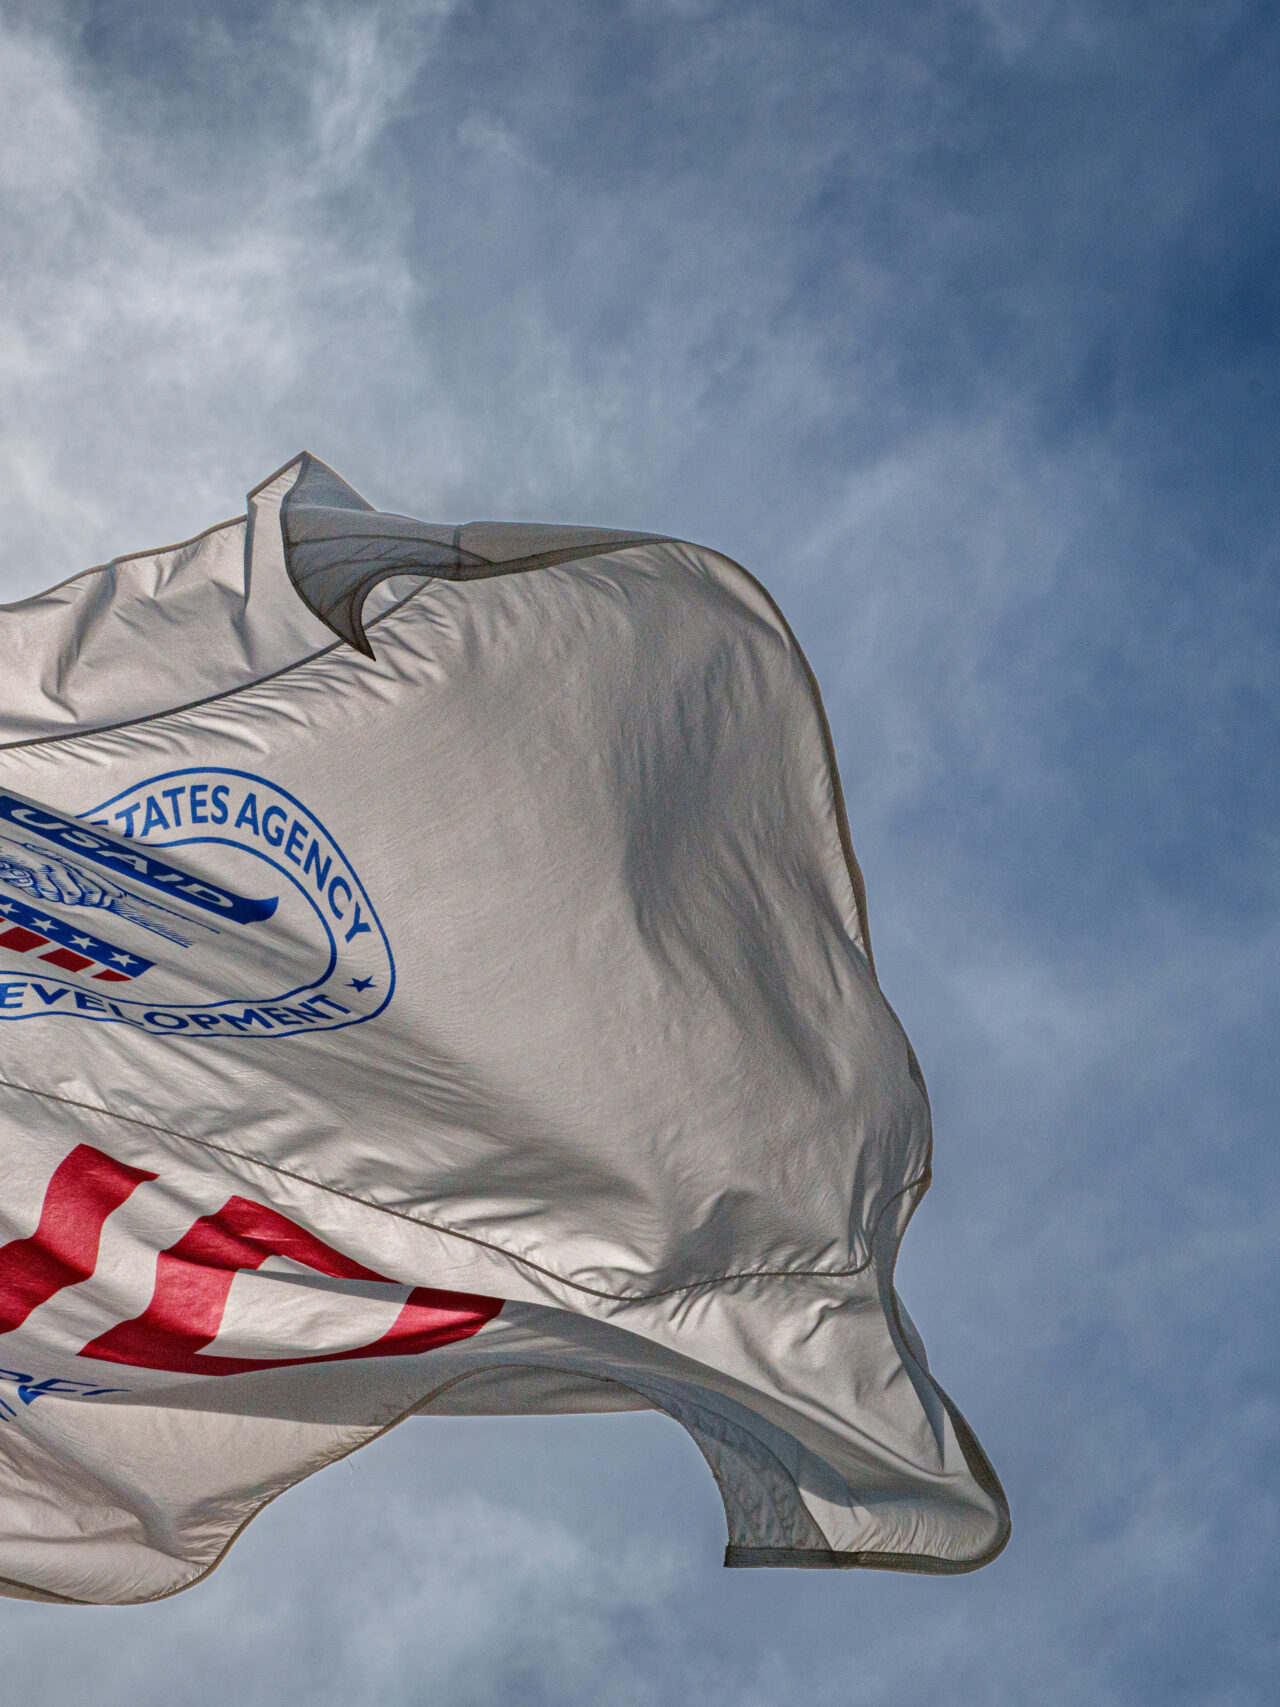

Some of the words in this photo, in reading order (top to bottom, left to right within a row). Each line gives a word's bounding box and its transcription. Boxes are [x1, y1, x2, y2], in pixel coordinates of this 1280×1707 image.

[10, 807, 235, 909] USAID
[90, 783, 231, 839] TATES
[233, 792, 372, 944] AGENCY
